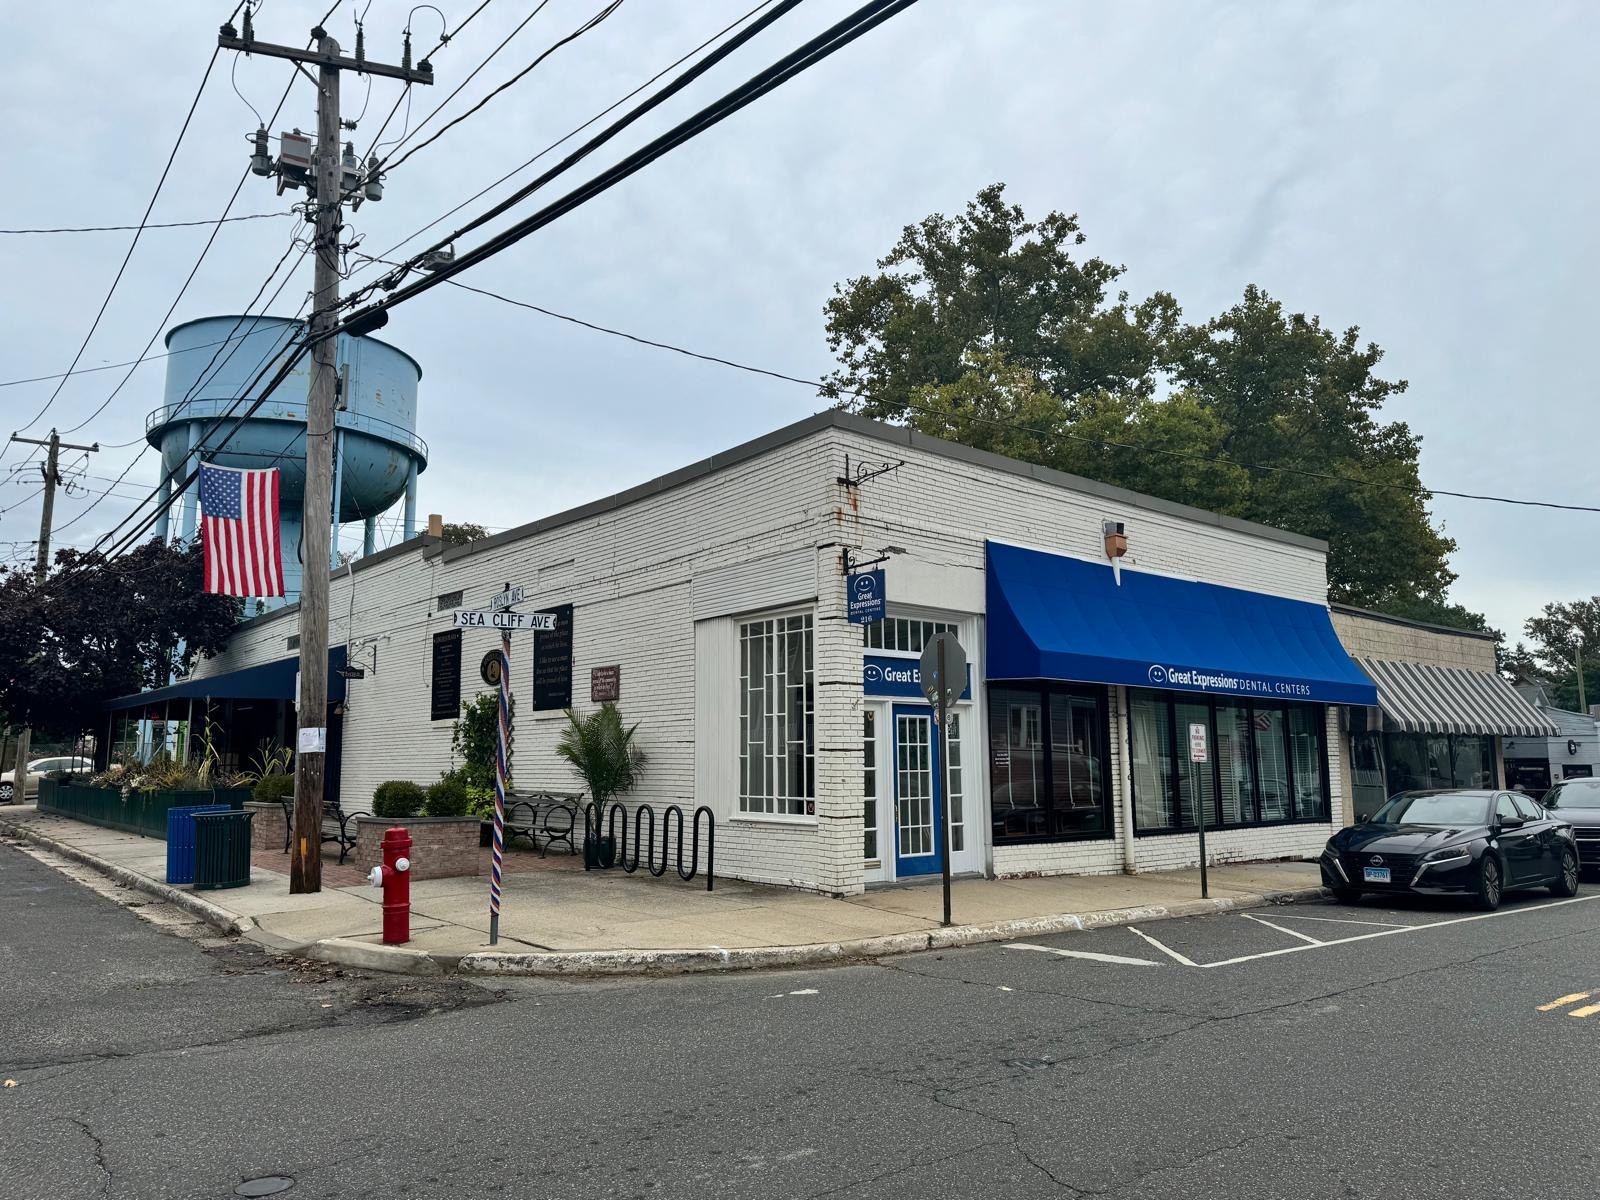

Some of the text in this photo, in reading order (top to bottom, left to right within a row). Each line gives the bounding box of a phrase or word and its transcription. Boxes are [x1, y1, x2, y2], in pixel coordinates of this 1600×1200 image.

[857, 592, 873, 601] Great
[850, 599, 881, 610] Expressions
[461, 612, 485, 626] SEA
[492, 613, 525, 627] CLIFF
[530, 615, 550, 628] AVE
[860, 615, 873, 623] 216
[884, 667, 912, 683] Great
[1168, 668, 1311, 696] Great Expressions DENTAL CENTERS
